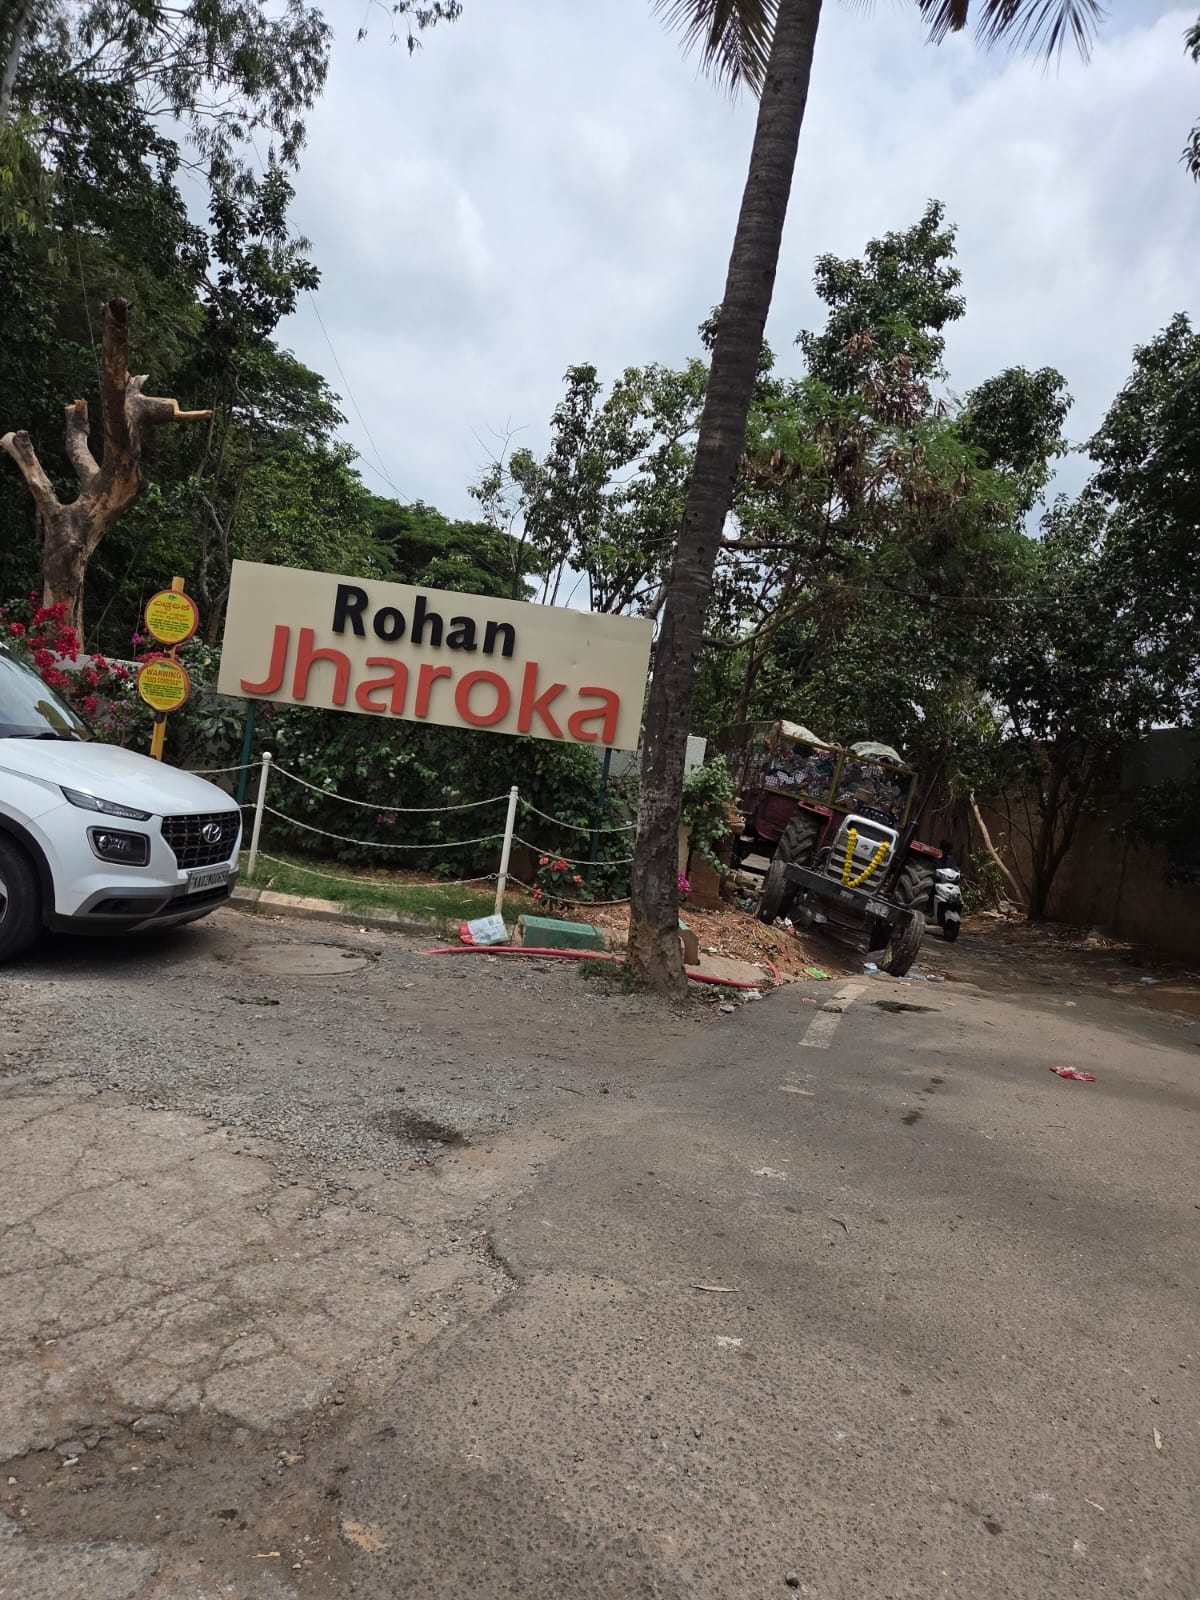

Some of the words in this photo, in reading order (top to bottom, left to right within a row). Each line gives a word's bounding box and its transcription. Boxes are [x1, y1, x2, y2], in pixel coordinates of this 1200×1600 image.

[332, 583, 516, 657] Rohan
[146, 668, 182, 679] WARNING
[240, 625, 620, 743] Jharoka
